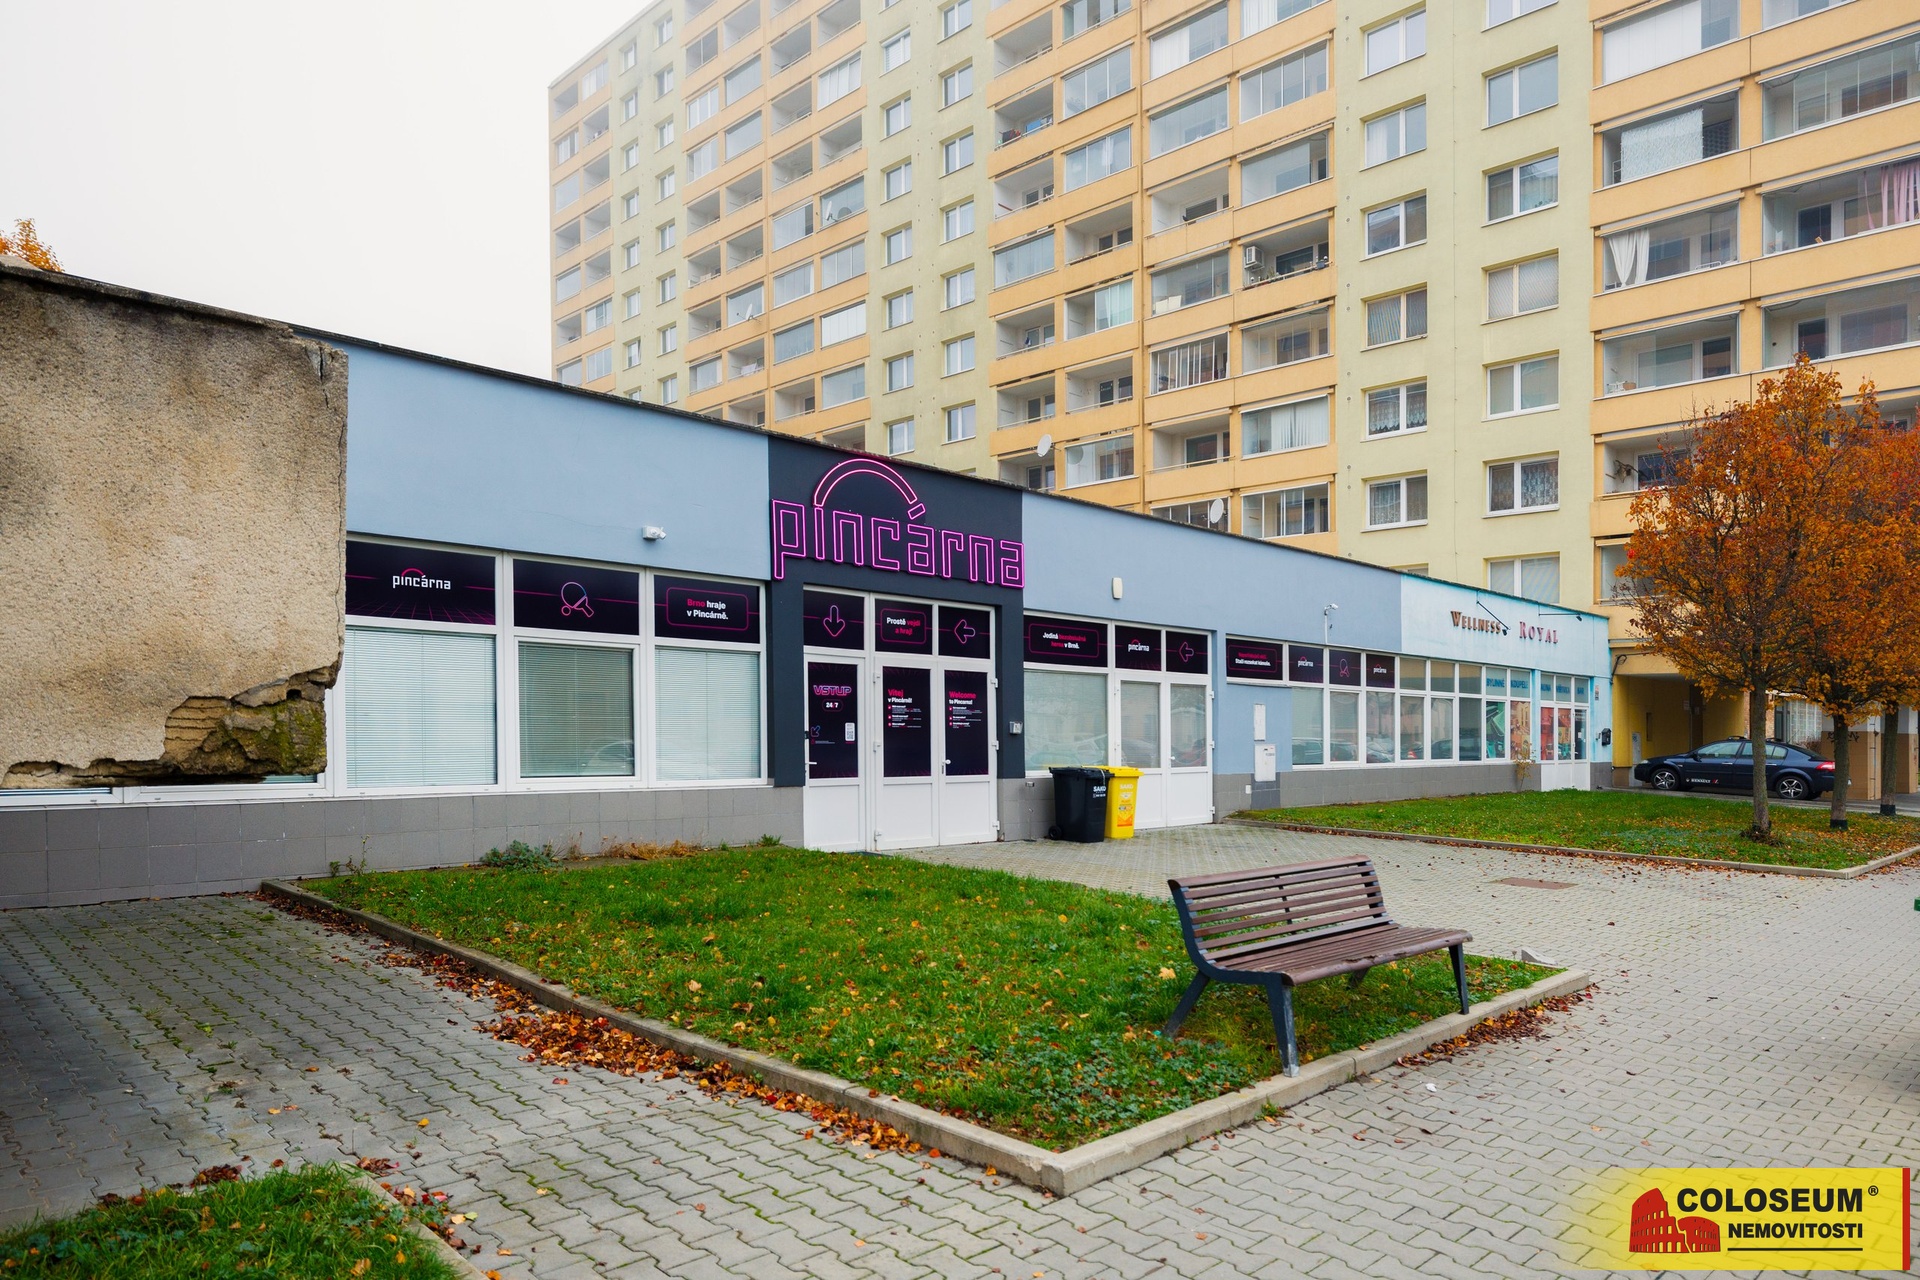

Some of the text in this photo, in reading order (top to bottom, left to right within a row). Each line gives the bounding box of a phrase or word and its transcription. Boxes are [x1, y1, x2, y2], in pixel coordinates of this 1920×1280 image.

[772, 499, 1025, 588] pincárna
[392, 574, 451, 590] pincárna
[687, 598, 726, 610] Brno hraje
[1519, 621, 1559, 644] ROYAL
[813, 685, 852, 696] VSTUP
